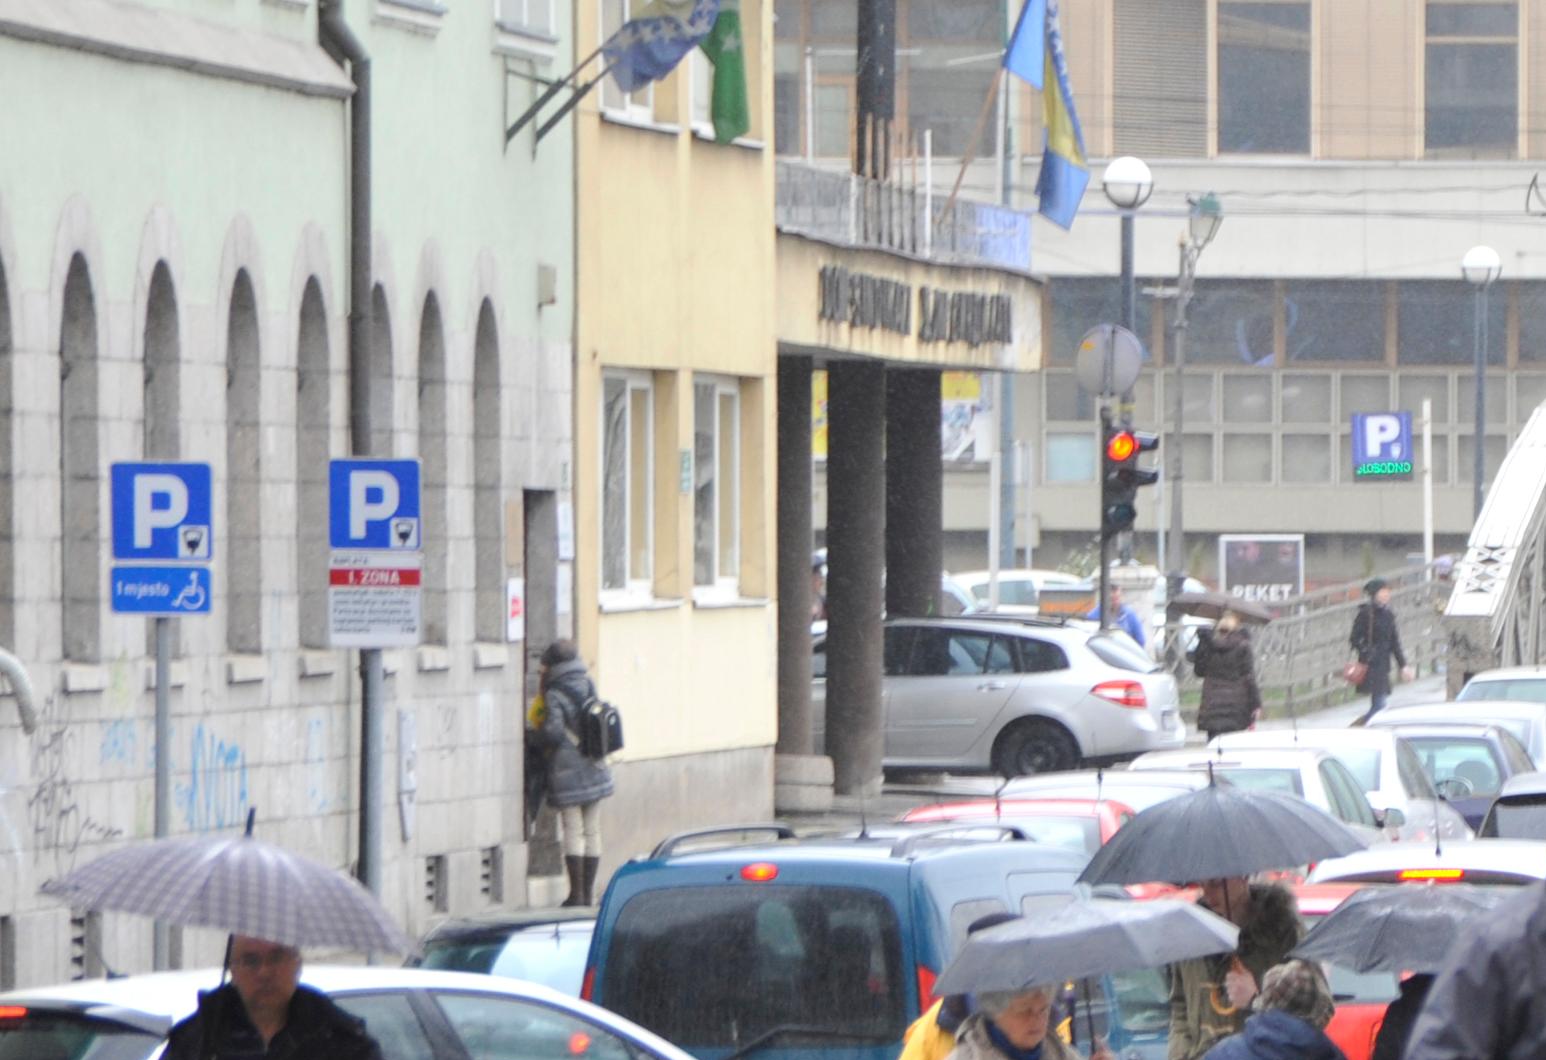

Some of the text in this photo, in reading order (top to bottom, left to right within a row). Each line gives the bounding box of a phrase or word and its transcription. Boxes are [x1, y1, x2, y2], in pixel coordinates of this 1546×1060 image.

[1366, 414, 1400, 457] P
[133, 473, 189, 549] P
[349, 470, 399, 540] P
[124, 581, 170, 600] mjesto
[359, 569, 400, 586] ZONA
